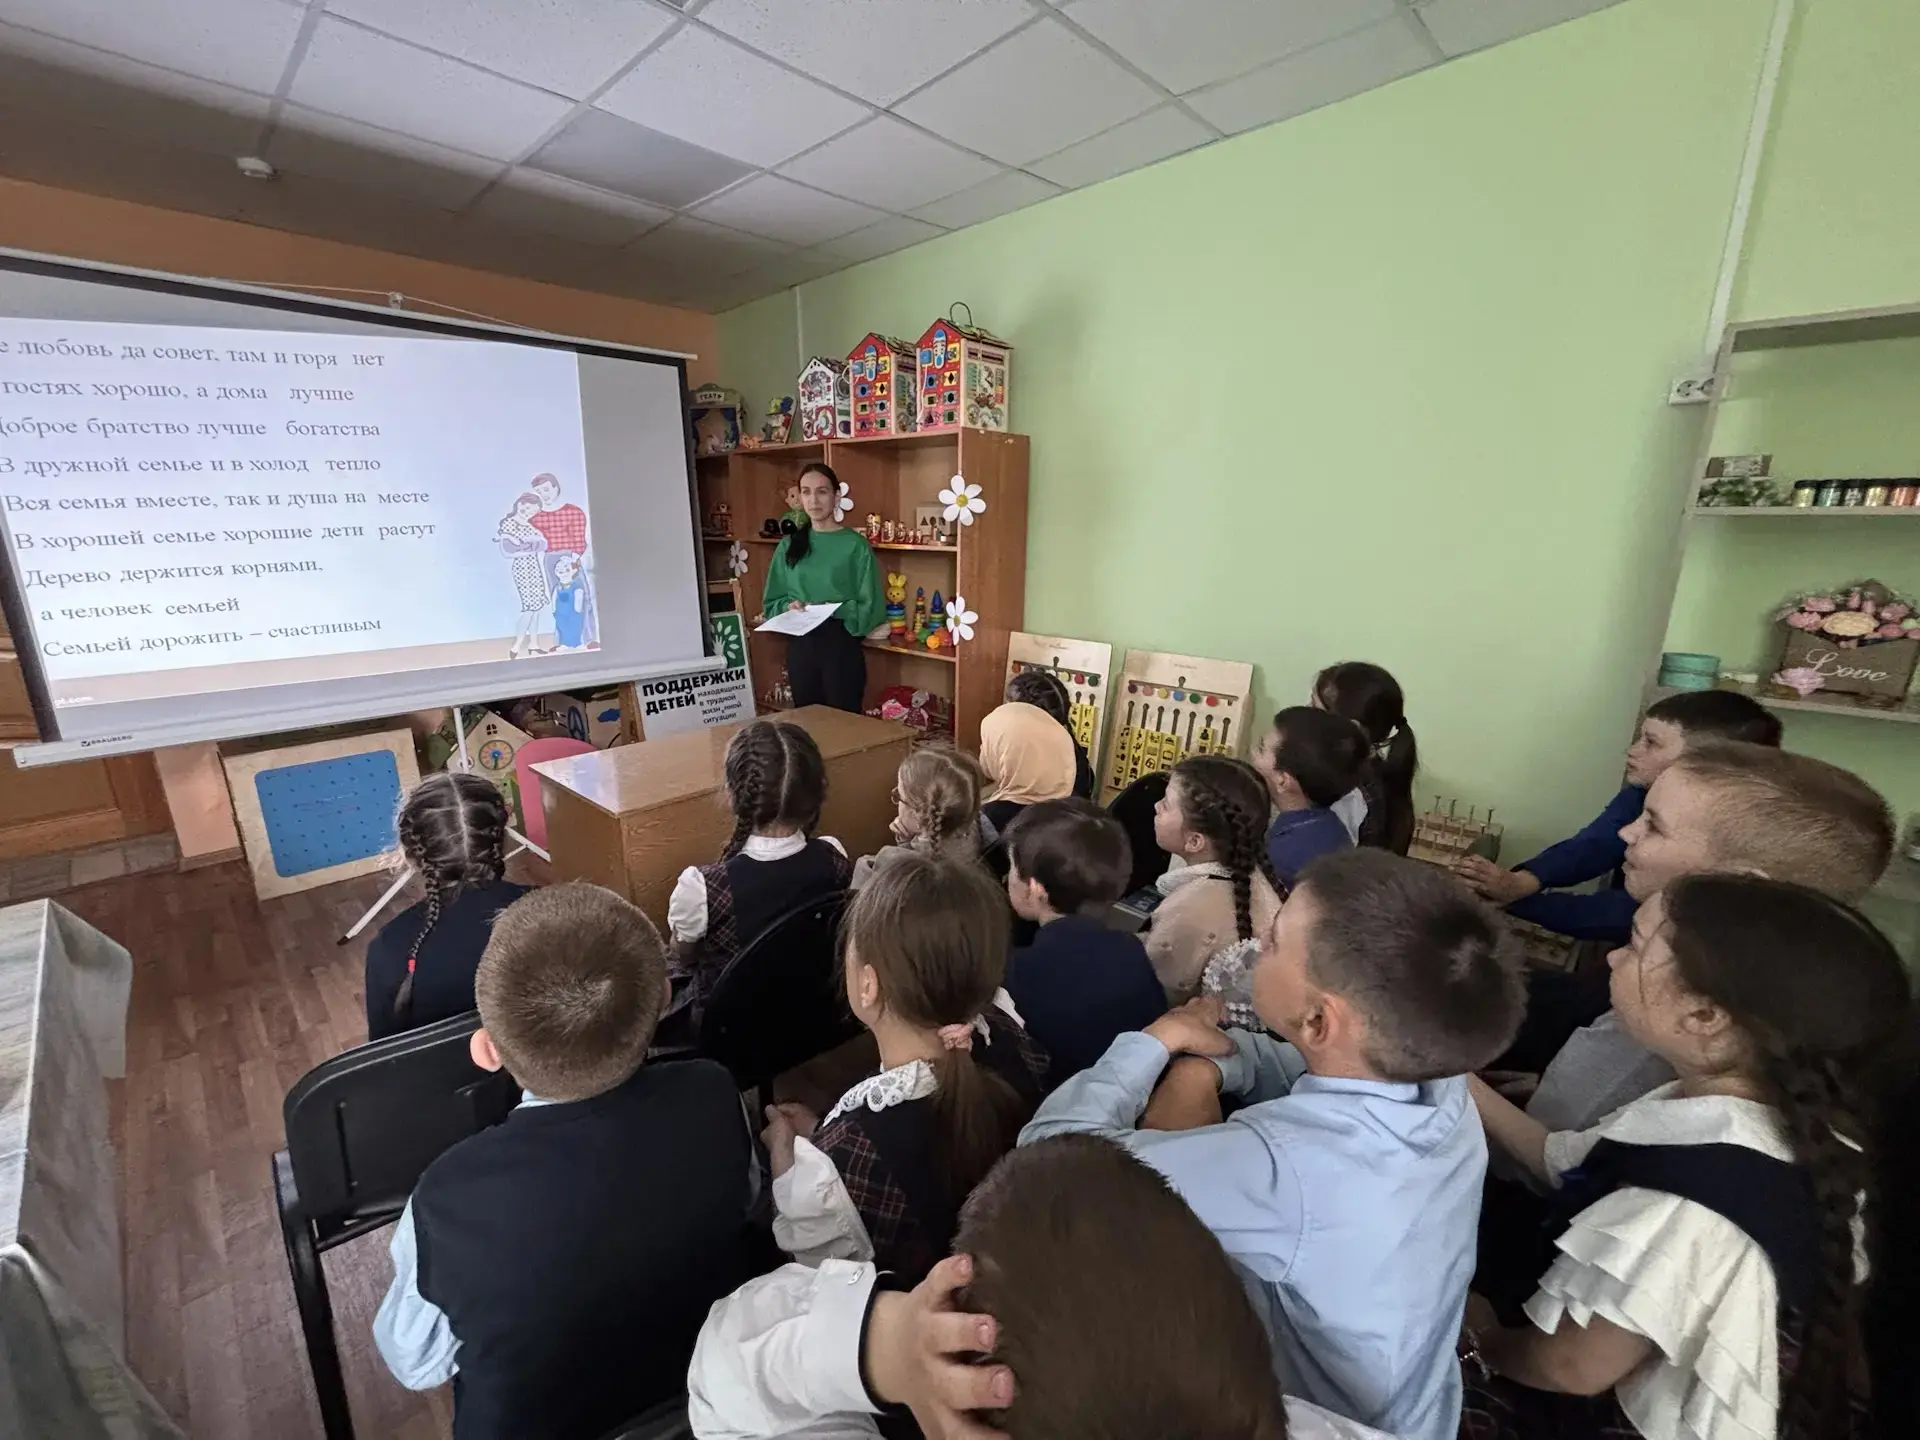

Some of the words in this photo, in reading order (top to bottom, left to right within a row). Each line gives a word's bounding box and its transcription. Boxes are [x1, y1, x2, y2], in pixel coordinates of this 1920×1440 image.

[18, 338, 113, 356] любовь
[121, 345, 146, 360] да
[226, 350, 267, 363] там
[273, 352, 288, 364] и
[293, 352, 338, 369] горя
[351, 354, 385, 366] нет
[2, 381, 83, 395] гостях
[92, 384, 188, 400] хорошо,
[196, 385, 208, 398] а
[216, 386, 268, 400] дома
[289, 388, 354, 404] лучше
[87, 418, 190, 438] братство
[197, 423, 267, 439] лучше
[286, 420, 380, 436] богатства
[0, 457, 15, 473] В
[24, 457, 130, 477] дружной
[138, 460, 203, 472] семье
[210, 460, 223, 471] и
[230, 460, 243, 471] в
[249, 459, 310, 473] холод
[325, 459, 381, 471] тепло
[5, 495, 52, 511] Вся
[58, 497, 127, 510] семья
[136, 495, 218, 509] вместе,
[225, 494, 261, 506] так
[266, 494, 280, 505] и
[287, 492, 338, 508] душа
[344, 491, 366, 503] на
[378, 491, 429, 504] месте
[14, 533, 34, 549] В
[41, 530, 145, 551] хорошей
[153, 531, 216, 544] семье
[222, 527, 313, 544] хорошие
[321, 525, 364, 539] дети
[378, 524, 435, 540] растут
[26, 570, 111, 588] Дерево
[120, 565, 224, 583] держится
[231, 560, 323, 577] корнями,
[41, 610, 54, 621] а
[61, 603, 152, 619] человек
[165, 597, 240, 615] семьей
[43, 636, 133, 657] Семьей
[139, 631, 243, 651] дорожить
[268, 620, 382, 639] счастливым
[642, 669, 746, 697] ПОДДЕРЖКИ
[646, 690, 696, 716] ДЕТЕЙ
[706, 693, 737, 706] трудной
[703, 712, 737, 724] ситуации
